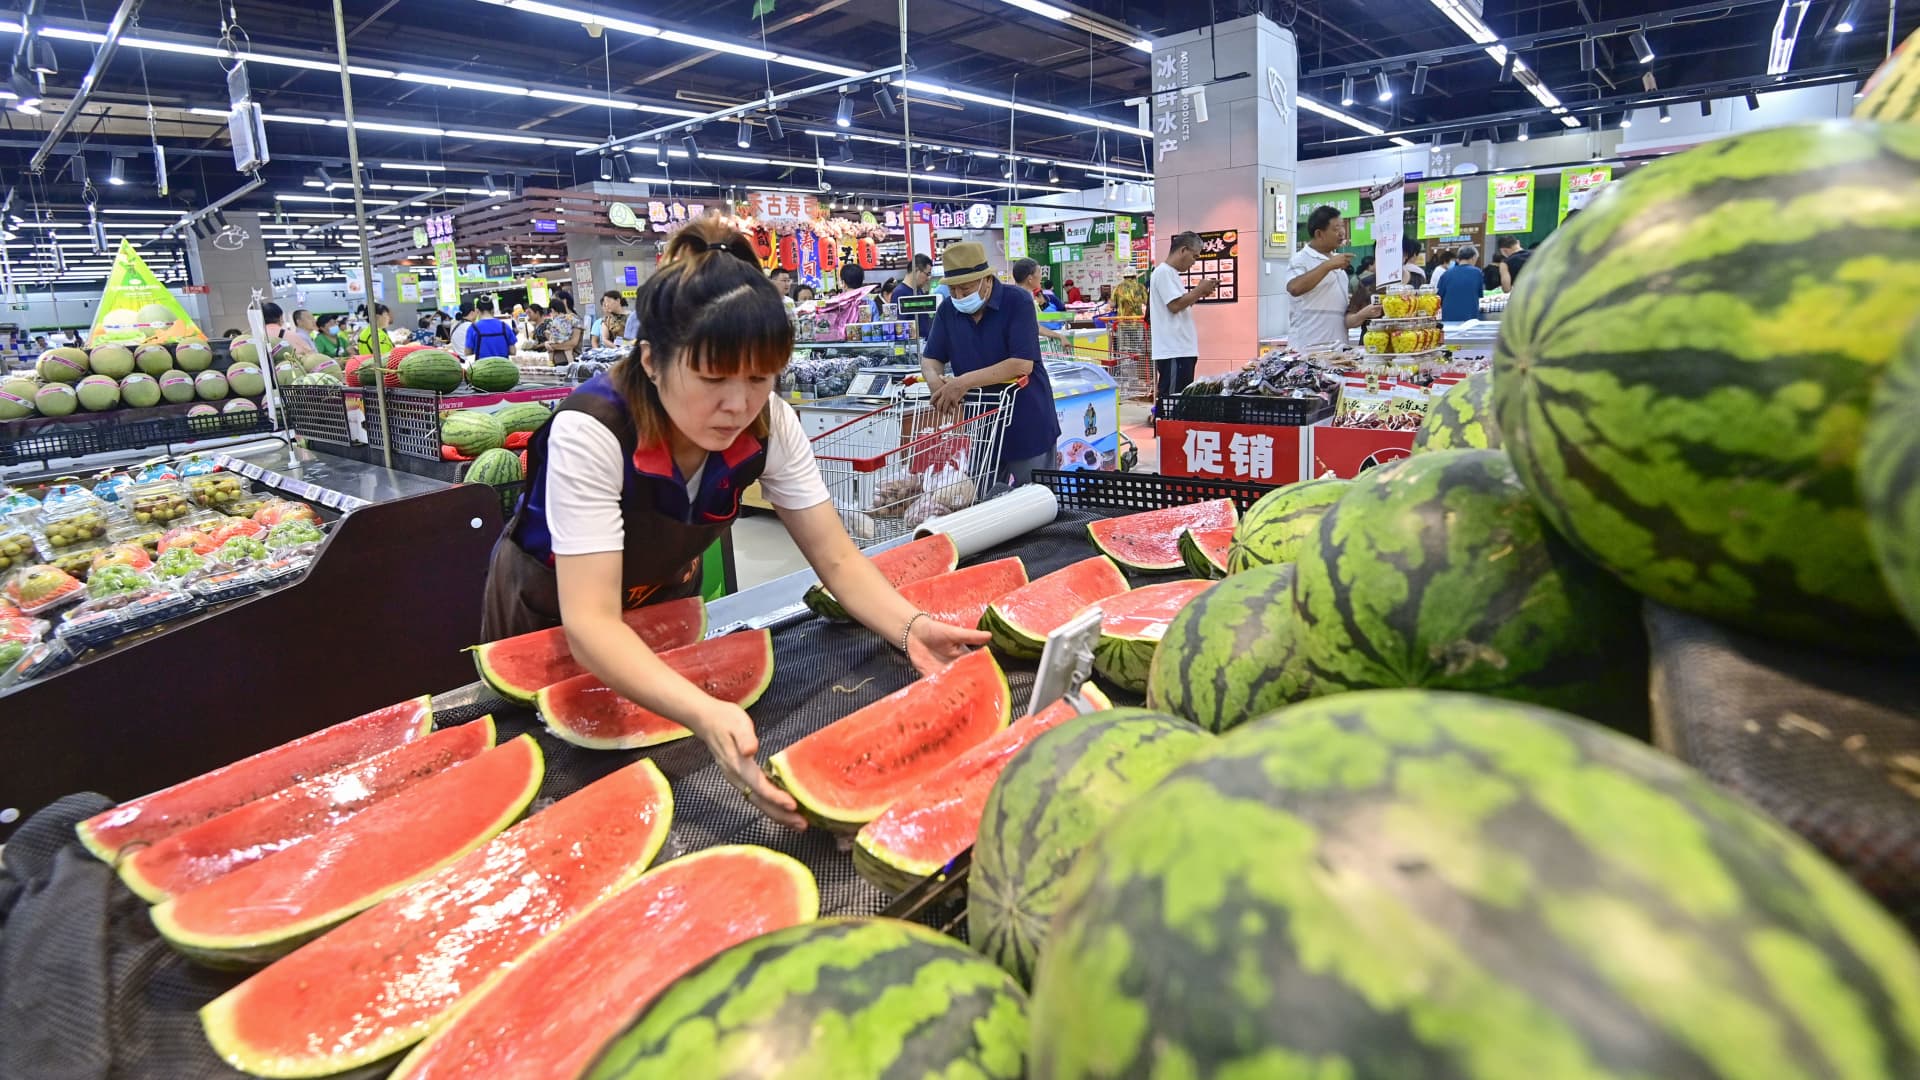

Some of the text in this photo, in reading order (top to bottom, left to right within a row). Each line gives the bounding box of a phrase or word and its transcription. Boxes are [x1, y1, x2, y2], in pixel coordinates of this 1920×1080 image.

[1180, 51, 1189, 88] AQUATI
[1157, 54, 1178, 162] 冰鲜水产
[800, 229, 816, 277] 寿司
[1182, 429, 1274, 479] 促销
